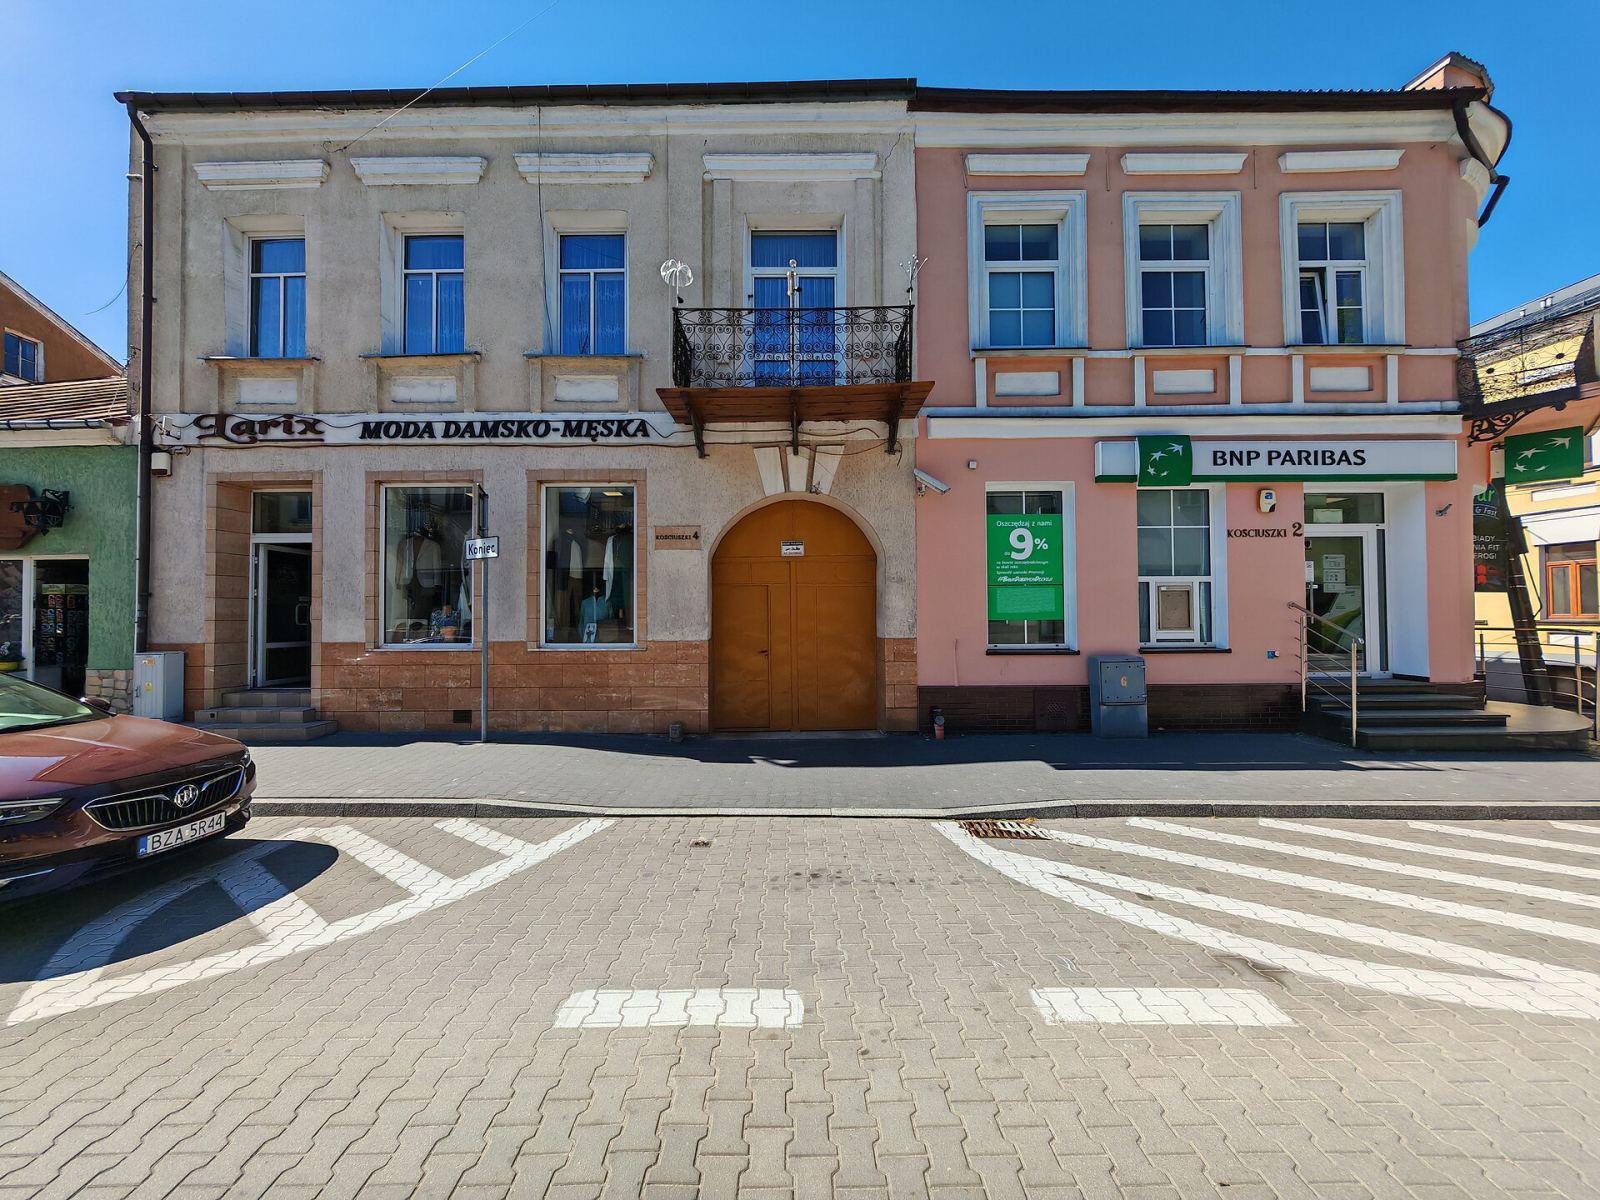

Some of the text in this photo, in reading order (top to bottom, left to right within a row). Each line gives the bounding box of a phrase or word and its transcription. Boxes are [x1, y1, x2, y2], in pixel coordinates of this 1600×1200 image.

[193, 413, 325, 444] Larix
[360, 419, 650, 441] MODA DAMSKO-MĘSKA
[1213, 449, 1366, 466] BNP PARIBAS
[996, 520, 1030, 528] Oszczędzaj
[1292, 522, 1303, 537] 2
[692, 531, 700, 540] 4
[468, 542, 496, 555] Koniec
[151, 828, 184, 850] BZA
[190, 814, 223, 837] 5R44
